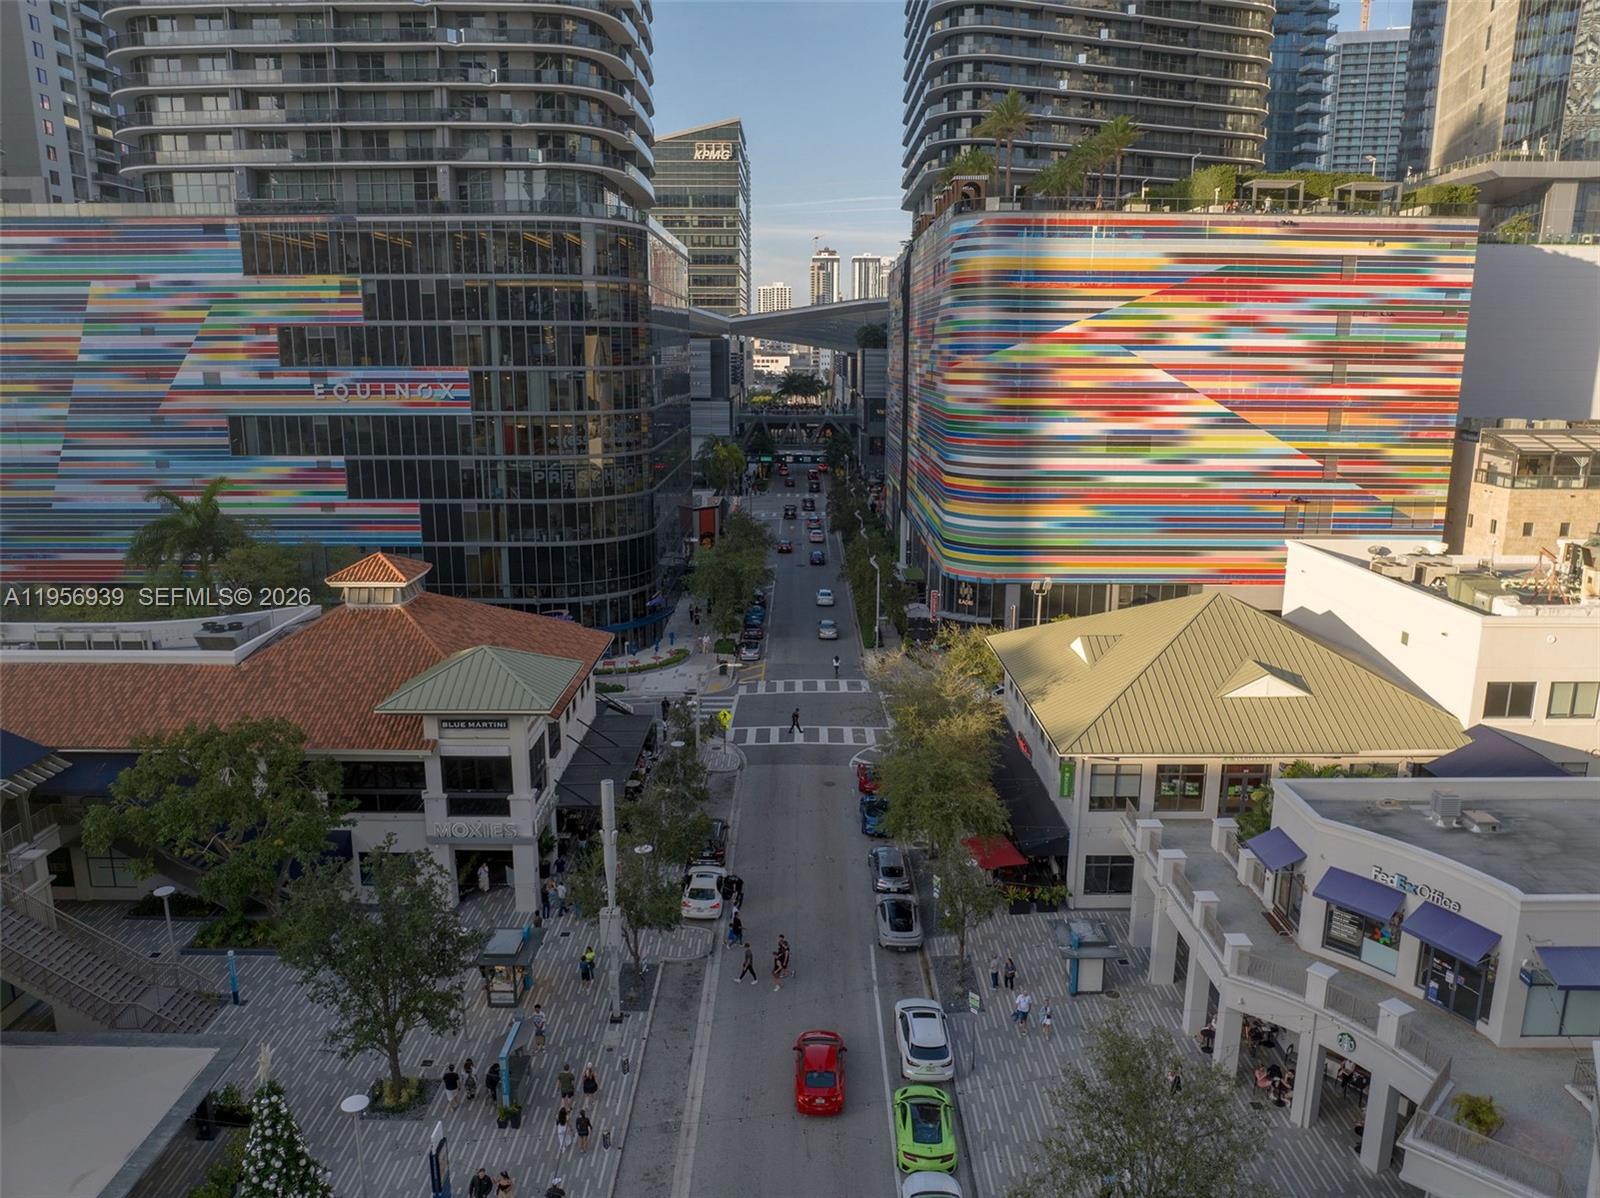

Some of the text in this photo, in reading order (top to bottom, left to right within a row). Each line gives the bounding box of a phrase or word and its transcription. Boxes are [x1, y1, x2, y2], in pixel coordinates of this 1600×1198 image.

[694, 149, 730, 160] KPMG
[314, 383, 455, 402] EQUINOX
[442, 721, 507, 729] BLUE MARTINI
[433, 822, 518, 838] MOXIES
[1370, 865, 1462, 912] FedEx Office
